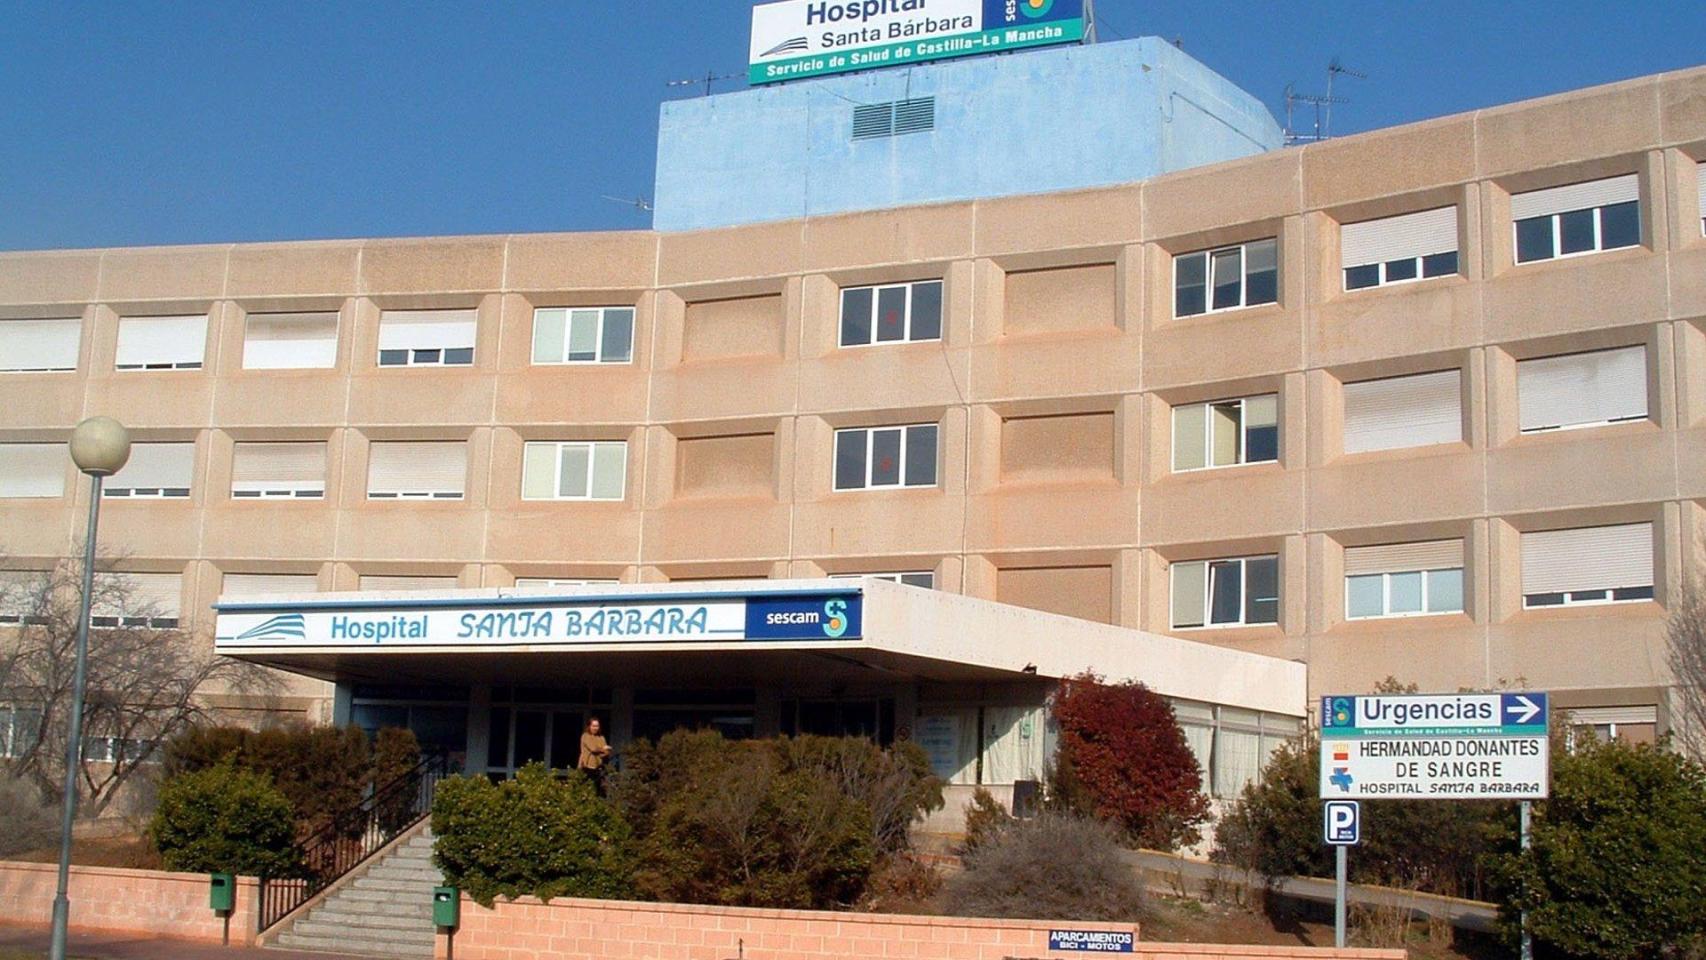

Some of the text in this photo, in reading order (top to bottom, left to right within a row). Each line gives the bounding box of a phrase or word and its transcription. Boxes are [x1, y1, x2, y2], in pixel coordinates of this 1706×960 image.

[821, 15, 973, 48] Santa Bárbara
[767, 59, 824, 76] Servicio
[829, 56, 845, 68] de
[851, 50, 889, 65] Salud
[895, 47, 911, 58] de
[1005, 26, 1063, 43] Mancha
[766, 610, 819, 624] sescam
[331, 615, 428, 643] Hospital
[457, 611, 552, 638] SANTA
[1363, 698, 1492, 724] Urgencias
[1360, 740, 1539, 757] HERMANDAD DONANTES
[1396, 762, 1503, 777] DE SANGRE
[1360, 783, 1423, 793] HOSPITAL
[1429, 783, 1474, 793] SANTA
[1330, 805, 1354, 839] P
[1050, 931, 1132, 944] APARCAMIENTOS
[1060, 941, 1078, 949] BICI
